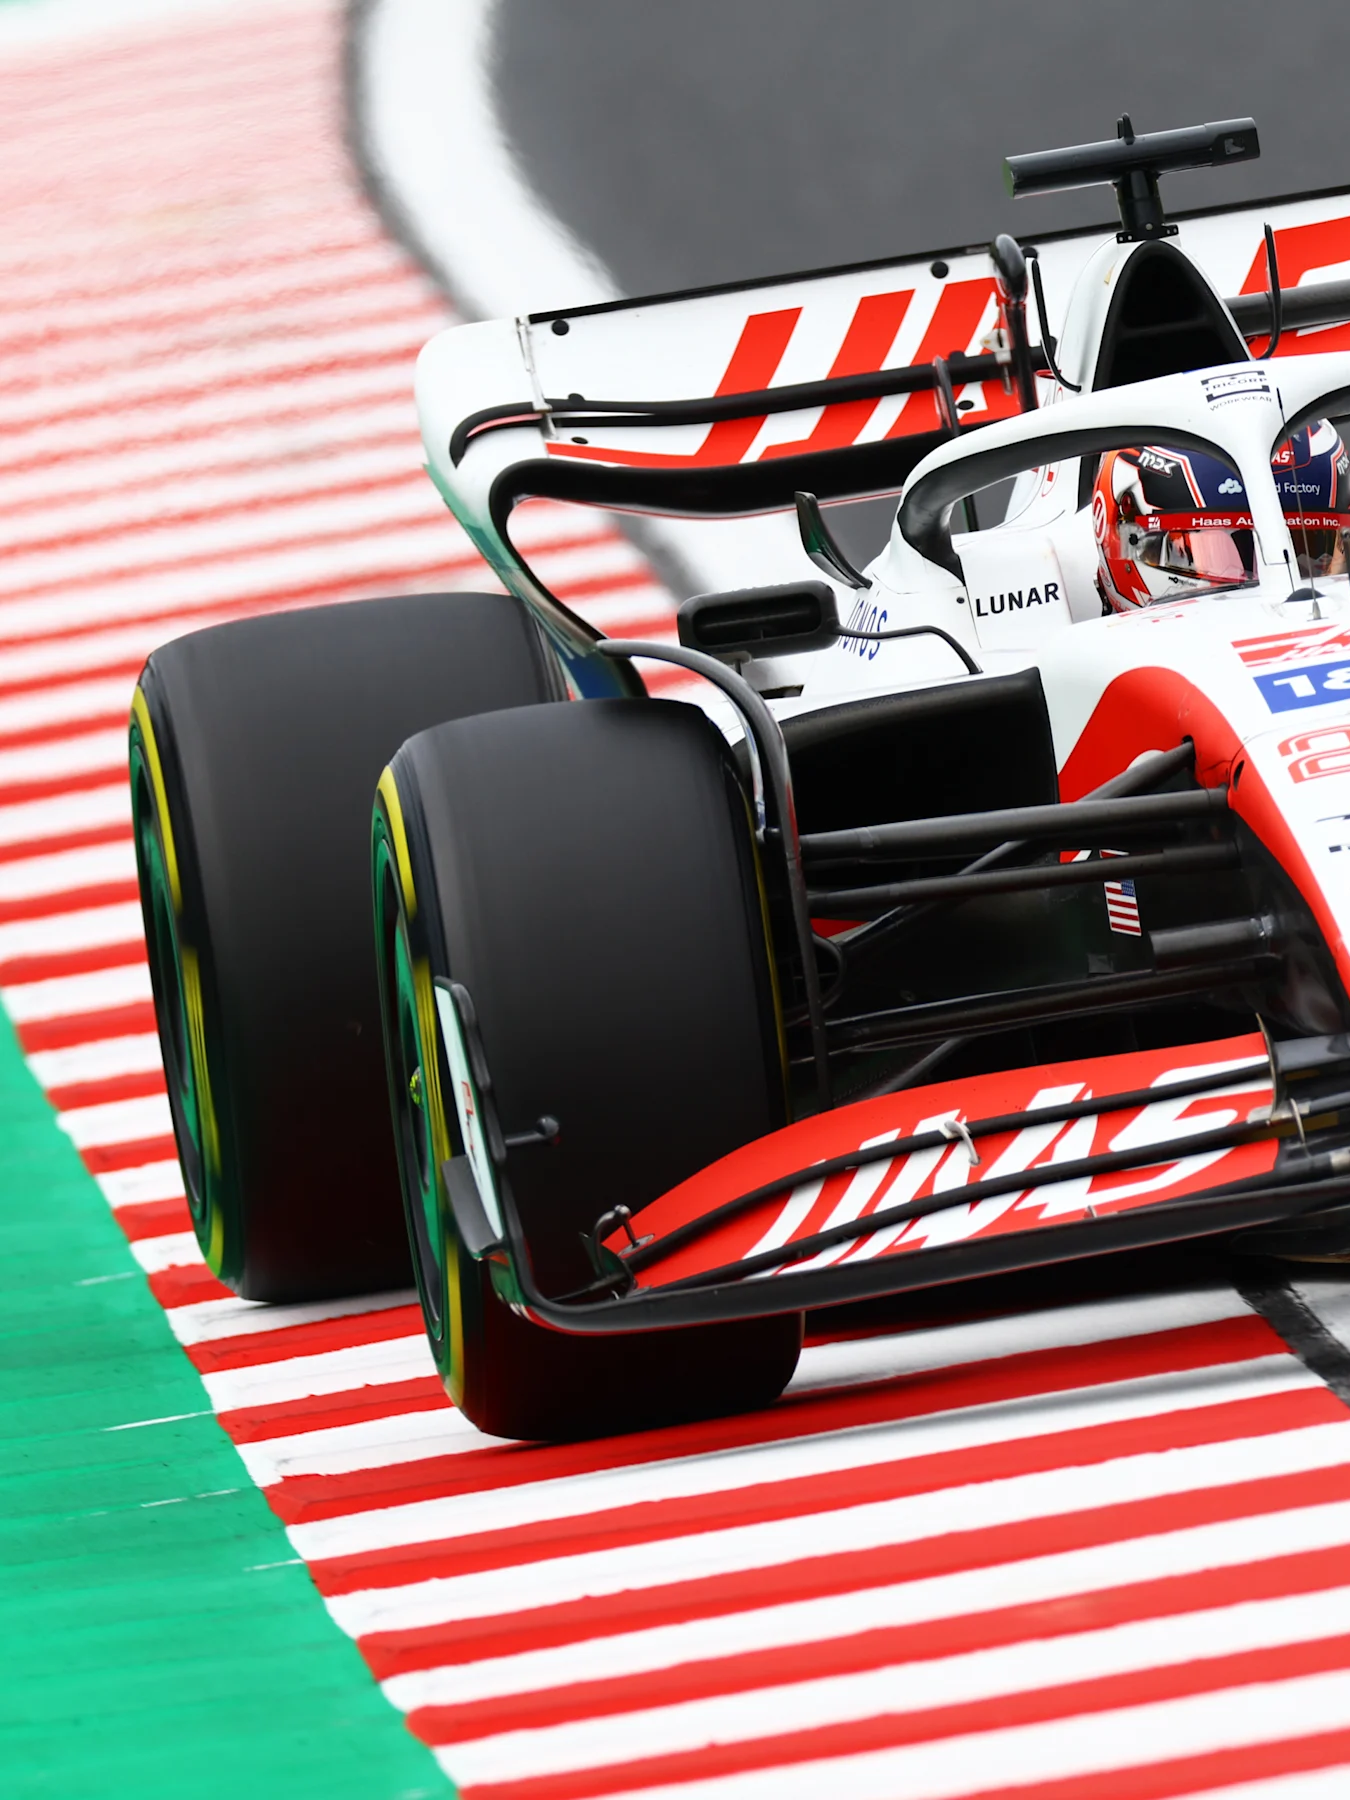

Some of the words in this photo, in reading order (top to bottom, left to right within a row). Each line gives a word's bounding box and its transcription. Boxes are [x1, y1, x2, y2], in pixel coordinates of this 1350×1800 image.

[1203, 377, 1268, 392] TRICORP
[1209, 395, 1272, 412] WORKWEAR
[1283, 482, 1321, 496] Factory
[1191, 517, 1232, 527] Haas
[1235, 516, 1320, 528] Auaton
[1322, 517, 1341, 528] Inc.
[975, 582, 1060, 617] LUNAR
